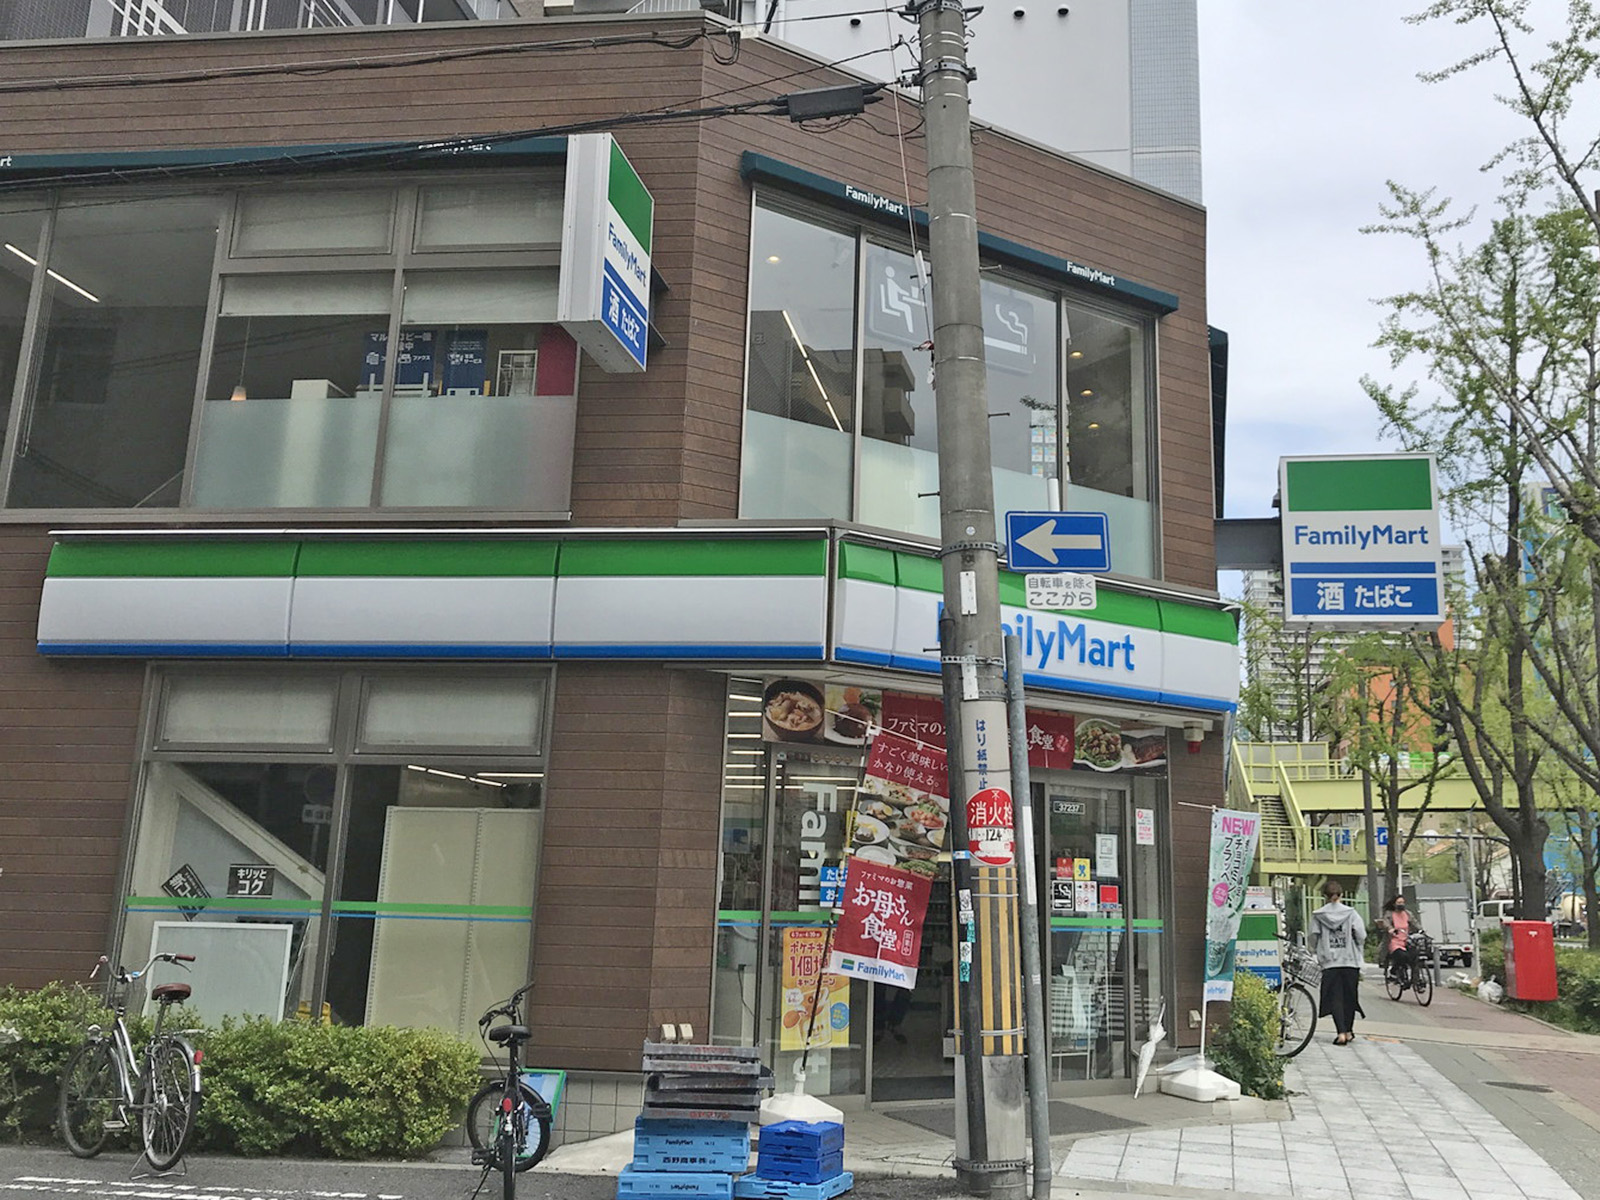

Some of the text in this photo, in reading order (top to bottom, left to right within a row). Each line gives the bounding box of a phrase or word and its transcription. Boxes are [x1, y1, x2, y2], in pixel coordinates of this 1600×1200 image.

[845, 184, 904, 215] FamilyMart
[609, 222, 647, 287] FamilyMart
[1066, 261, 1115, 286] FamilyMart
[609, 288, 640, 349] 酒 たばこ
[1295, 525, 1429, 550] FamilyMart
[1028, 577, 1093, 589] 自転車を除く
[1029, 591, 1093, 607] ここから
[1317, 582, 1413, 611] 酒 たばこ
[888, 717, 946, 736] ファミマの
[975, 719, 988, 790] はり紙禁止
[970, 800, 1013, 825] 消火栓
[237, 868, 267, 880] キリッと
[238, 880, 264, 895] コク
[852, 881, 914, 926] お母さん
[860, 913, 898, 951] 食堂
[1235, 949, 1278, 957] FamilyMart
[857, 962, 905, 981] FamilyMart
